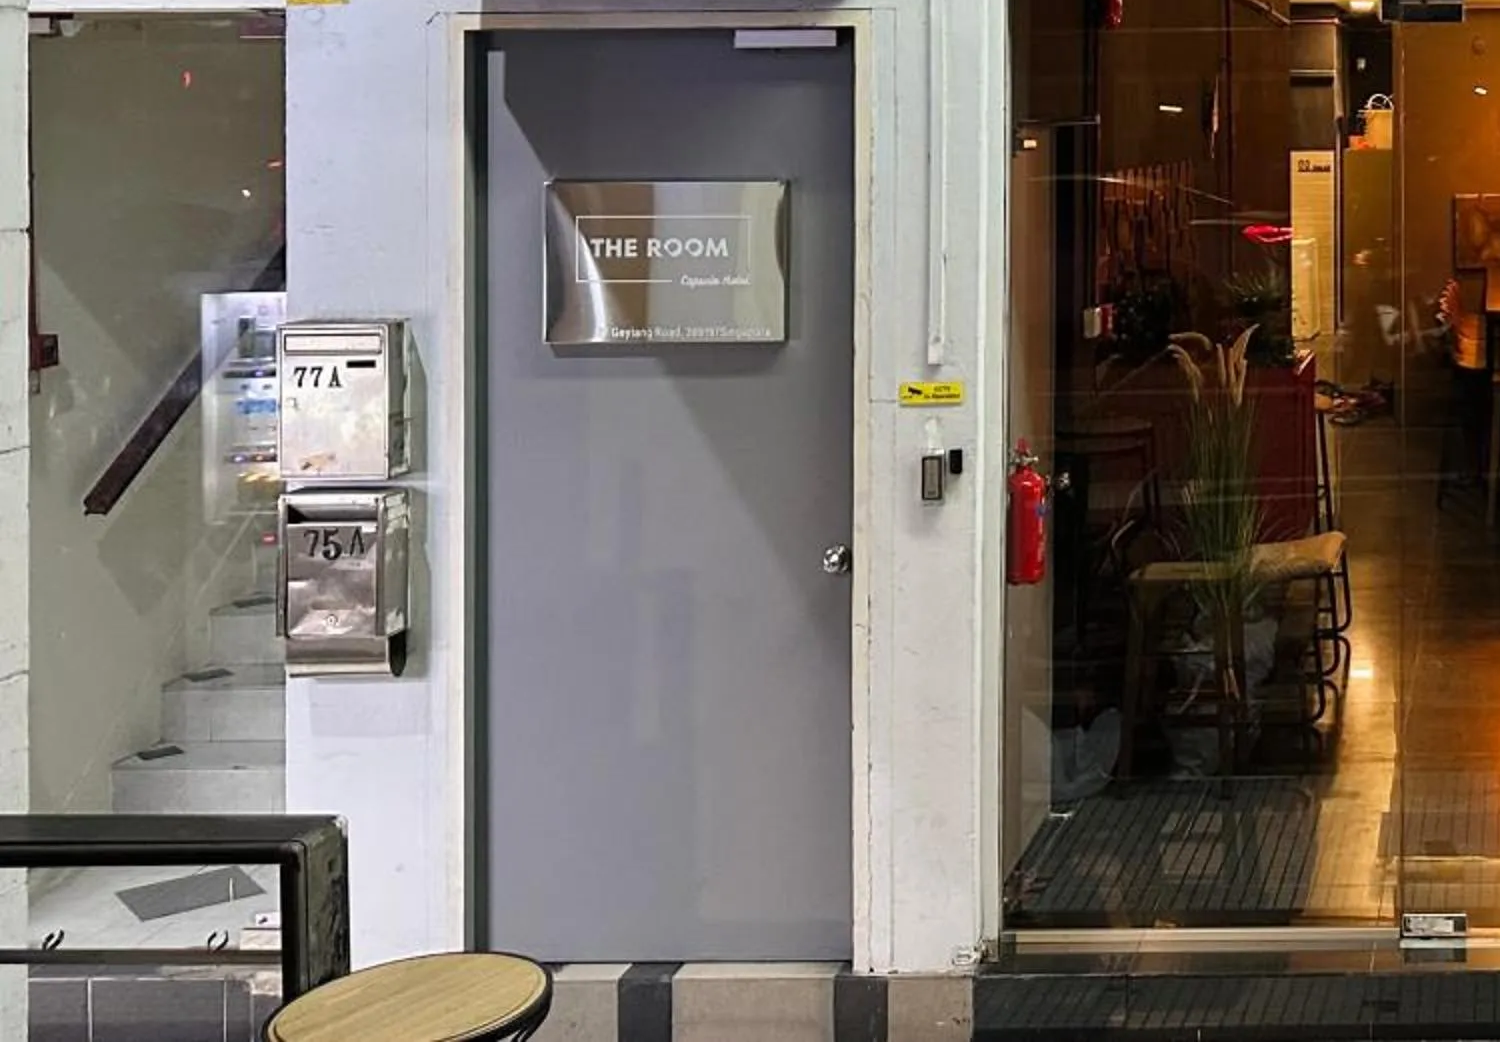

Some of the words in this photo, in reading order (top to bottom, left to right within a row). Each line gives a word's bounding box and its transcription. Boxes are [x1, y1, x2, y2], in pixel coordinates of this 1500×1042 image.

[590, 237, 638, 258] THE
[646, 237, 729, 258] ROOM
[293, 366, 342, 388] 77A
[303, 527, 365, 561] 75A
